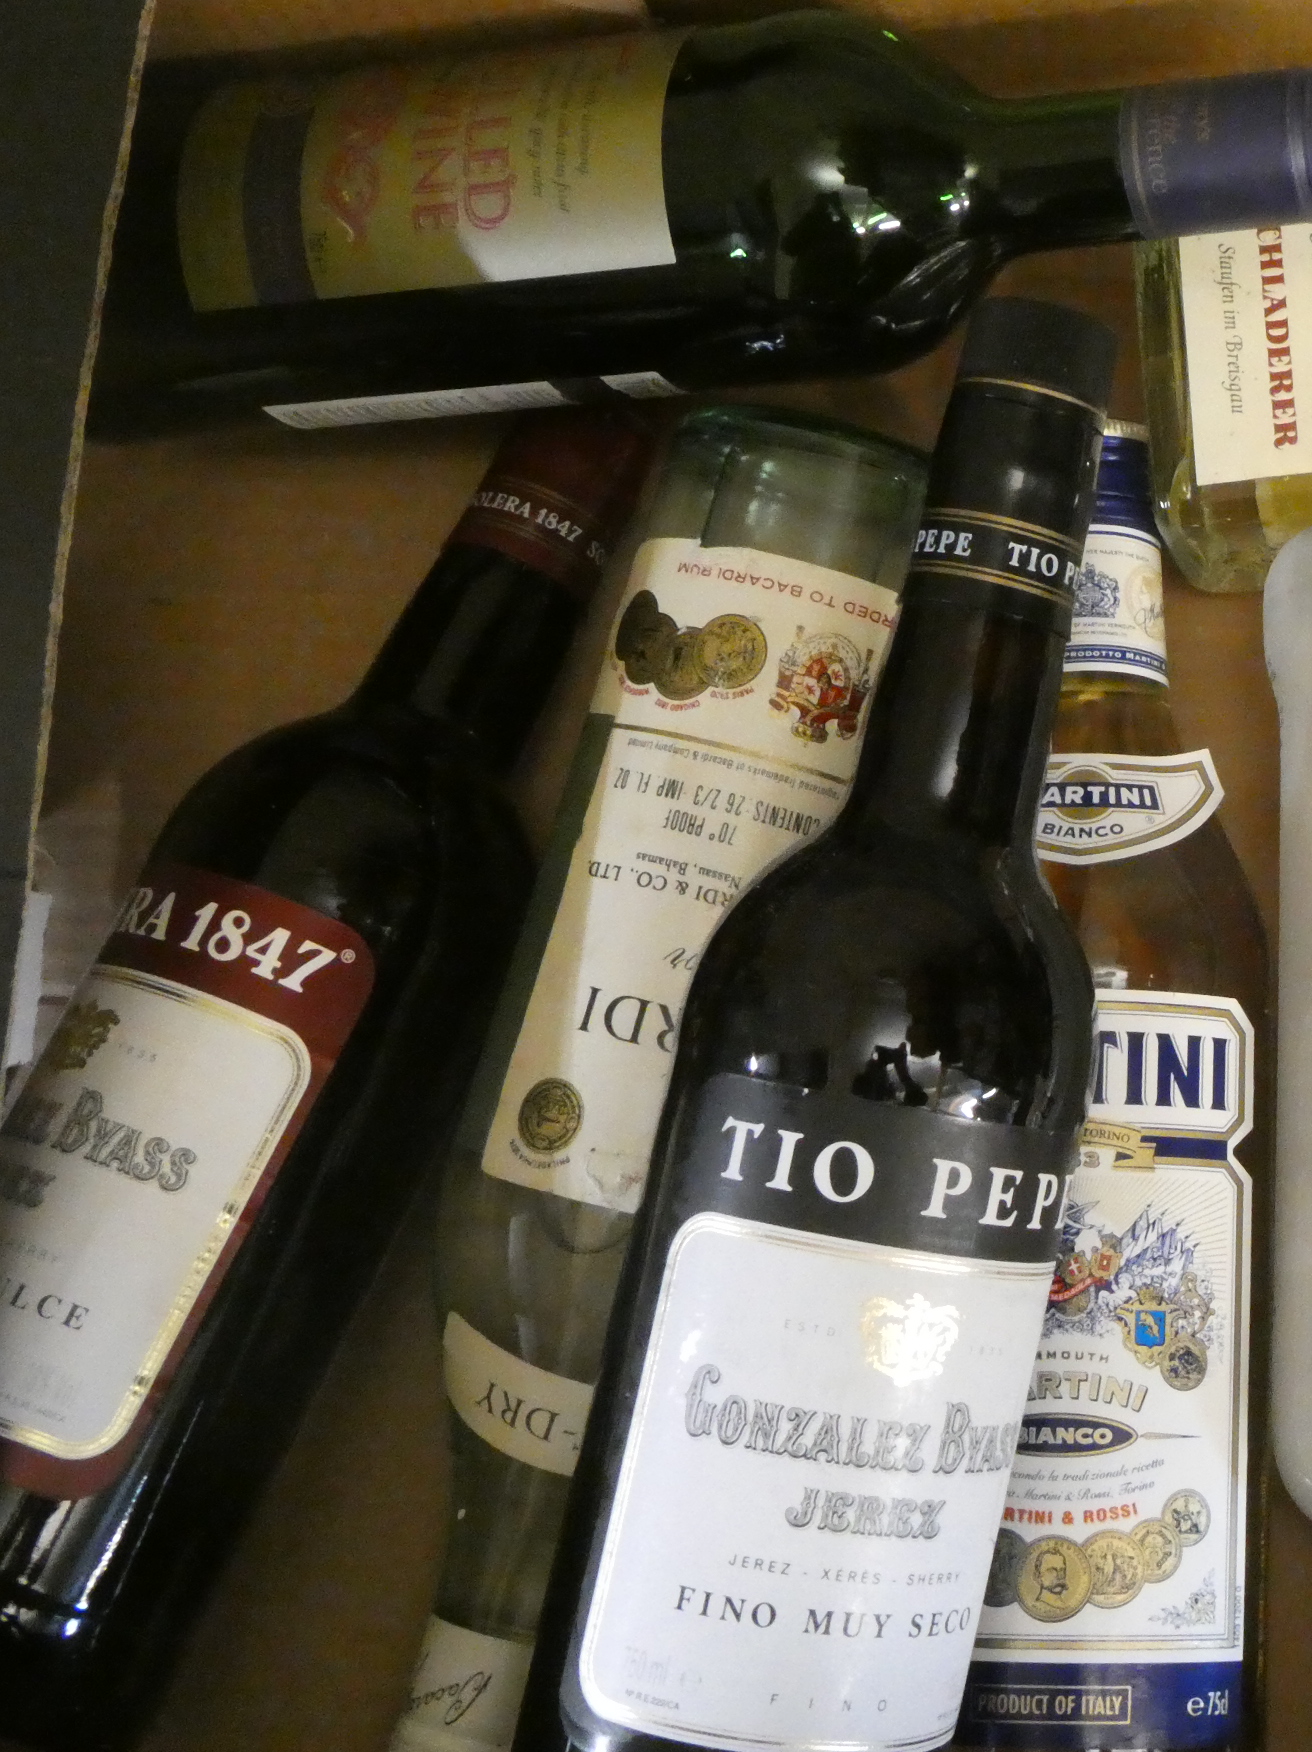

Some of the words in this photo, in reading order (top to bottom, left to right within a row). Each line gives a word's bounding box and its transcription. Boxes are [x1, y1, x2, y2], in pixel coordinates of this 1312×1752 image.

[1217, 242, 1237, 304] Staufen
[1224, 310, 1237, 330] im
[1256, 226, 1299, 451] CHLADERER
[1221, 336, 1245, 415] Breisgau
[534, 504, 584, 544] 1847
[914, 528, 973, 558] PEPE
[1007, 540, 1060, 578] TIO
[677, 561, 713, 578] RUM
[716, 568, 804, 599] BACARDI
[809, 589, 837, 608] TO
[843, 601, 897, 628] RDED
[1064, 650, 1122, 659] PRODOTTO
[724, 793, 747, 816] 26
[1041, 785, 1153, 807] ARTINI
[663, 808, 707, 837] PROOF
[1040, 822, 1125, 840] BIANCO
[635, 850, 690, 876] Bahamas
[675, 879, 690, 896] &
[1091, 1030, 1232, 1113] TINI
[50, 1086, 198, 1193] BYASS
[719, 1115, 876, 1203] TIO
[0, 1278, 90, 1331] LCE
[1034, 1349, 1110, 1365] MOUTH
[1026, 1370, 1150, 1414] RTINI
[684, 1363, 932, 1475] GONZALEZ
[784, 1486, 947, 1541] JEREZ
[1002, 1506, 1054, 1526] RTINI
[1060, 1509, 1075, 1526] &
[1082, 1502, 1140, 1525] ROSSI
[728, 1552, 792, 1577] JEREZ
[906, 1571, 962, 1587] SHERRY
[673, 1584, 778, 1630] FINO
[802, 1607, 894, 1640] MUY
[907, 1606, 973, 1640] SECO
[978, 1694, 1049, 1716] PRODUCT
[1055, 1694, 1077, 1716] OF
[1081, 1694, 1124, 1717] ITALY
